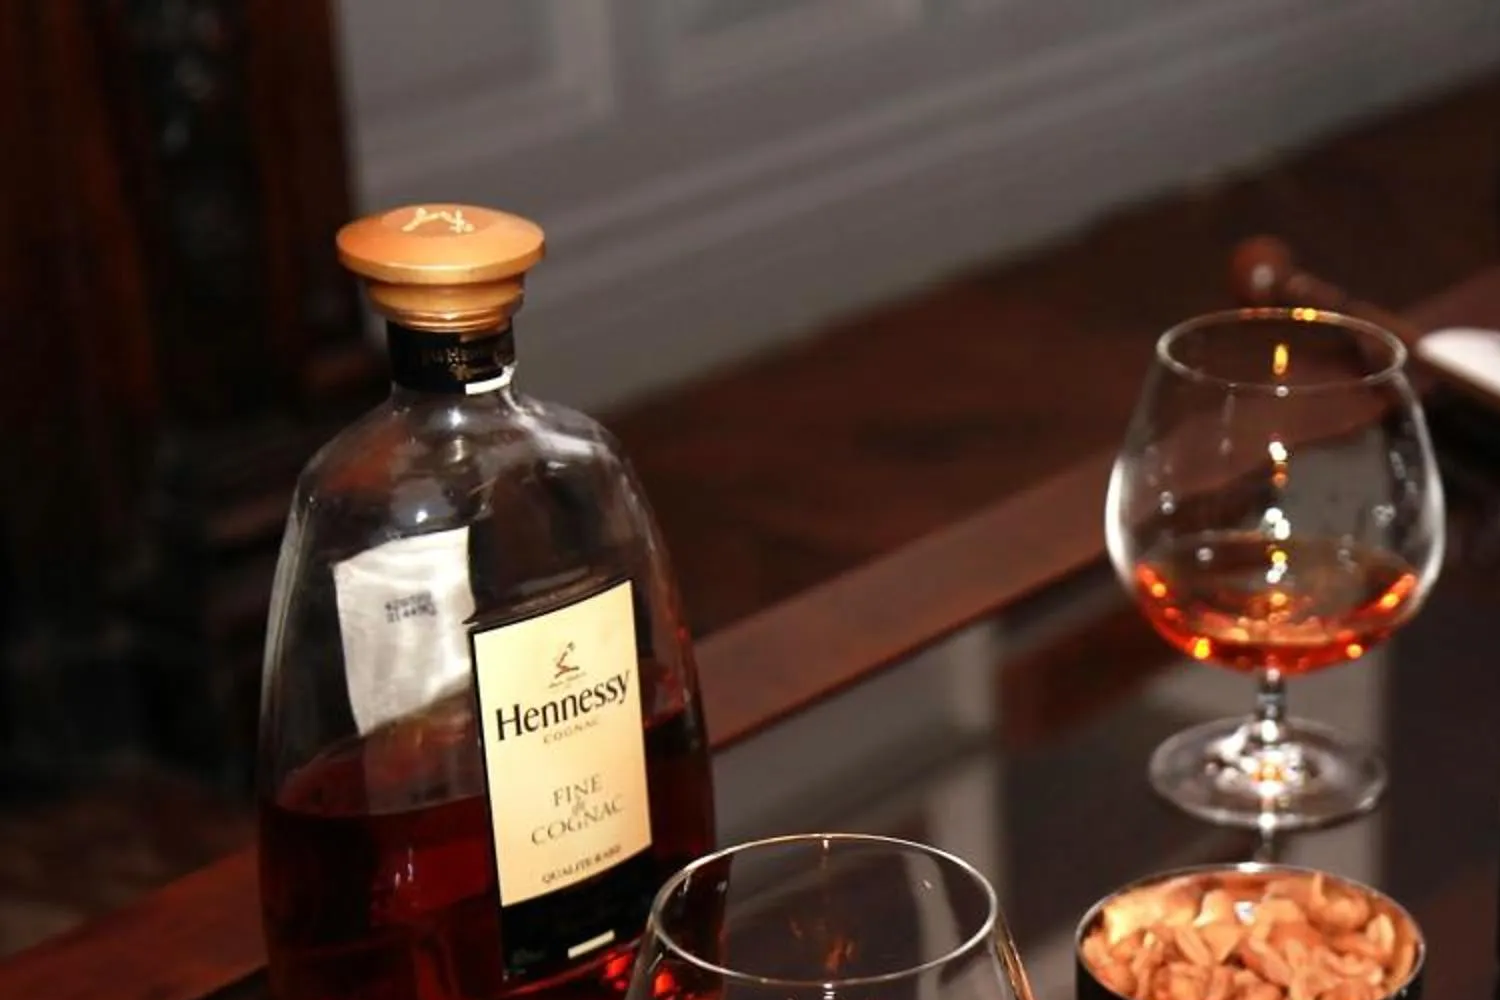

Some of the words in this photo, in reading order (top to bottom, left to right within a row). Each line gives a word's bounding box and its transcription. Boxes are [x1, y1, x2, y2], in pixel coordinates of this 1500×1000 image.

[495, 669, 631, 742] Hennessy
[543, 717, 599, 744] COGNAC
[553, 773, 603, 807] FINE
[531, 793, 625, 846] COGNAC
